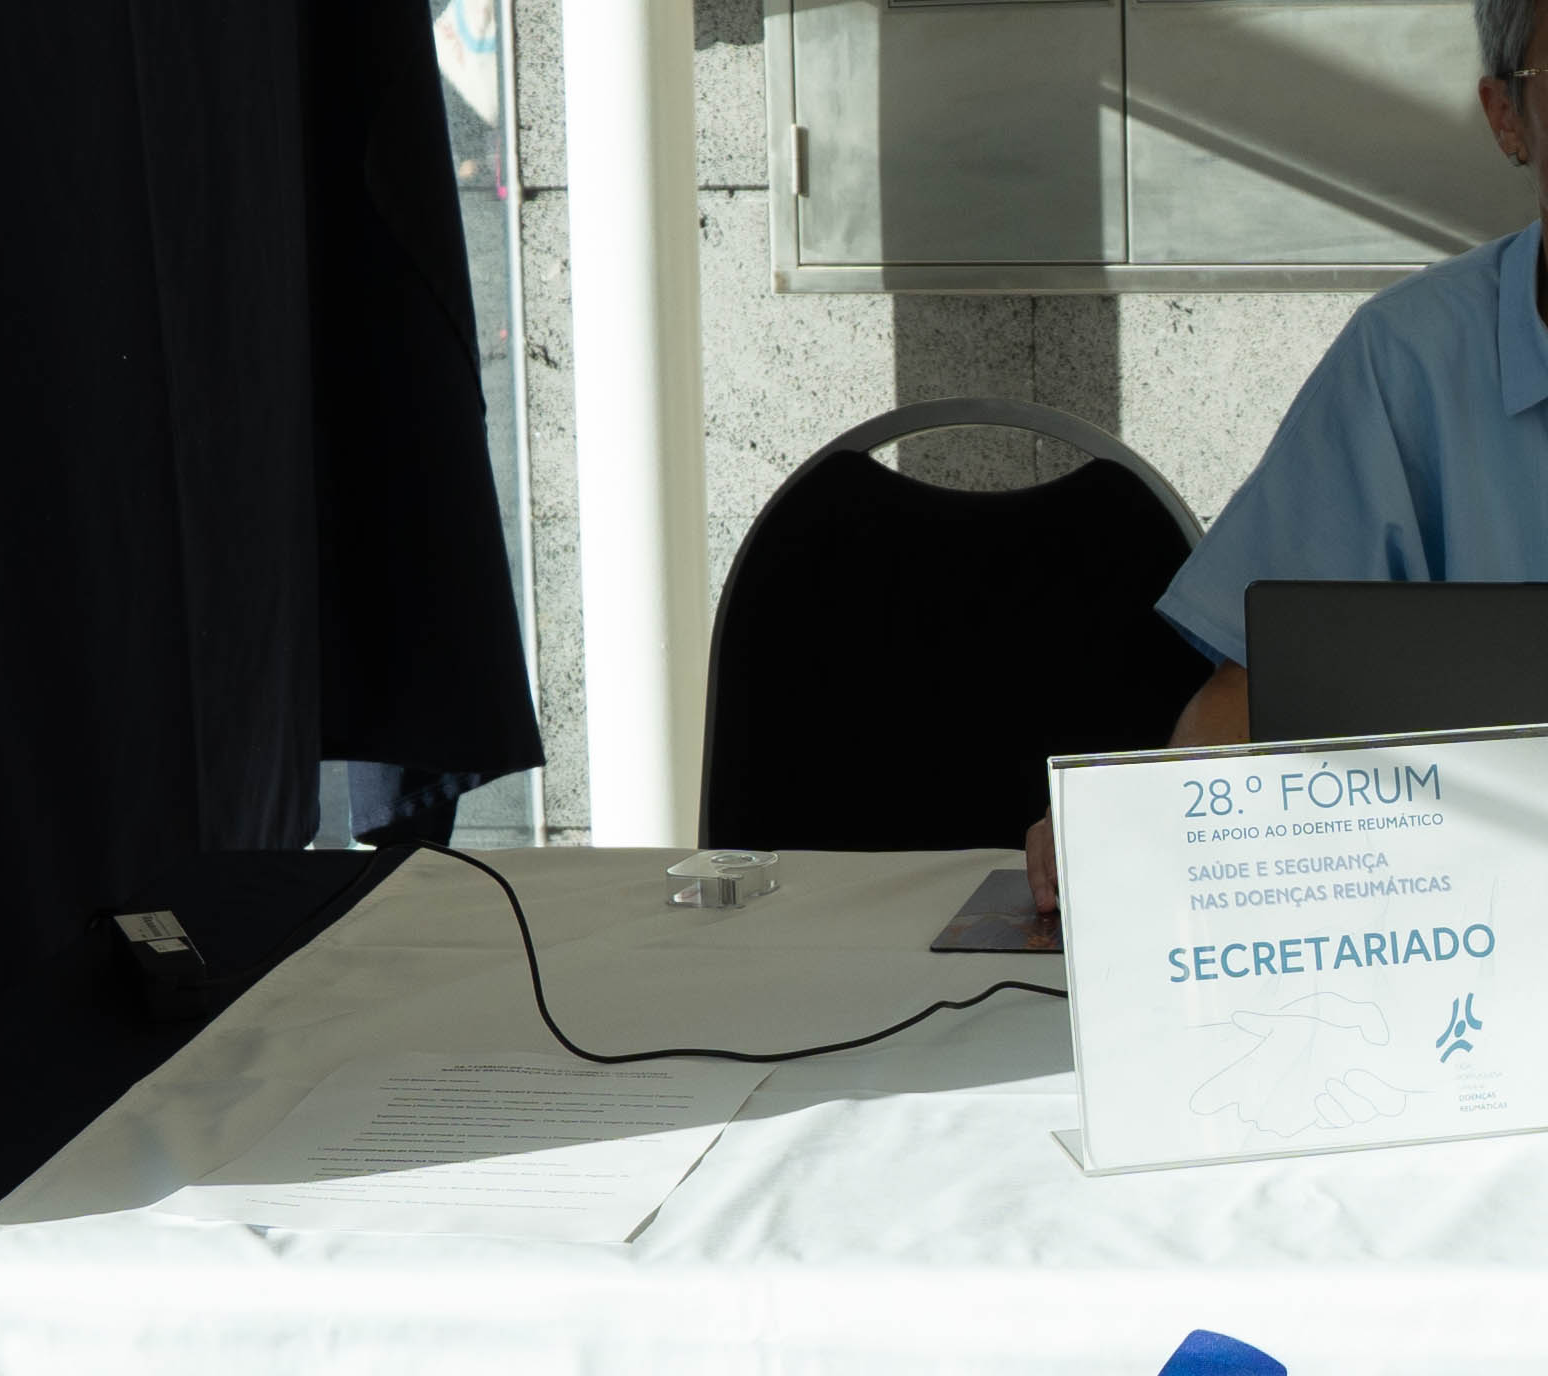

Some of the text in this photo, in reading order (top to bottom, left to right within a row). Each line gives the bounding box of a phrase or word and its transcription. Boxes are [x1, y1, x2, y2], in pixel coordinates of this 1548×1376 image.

[1183, 762, 1441, 818] 28.º FÓRUM
[1187, 813, 1444, 843] DE APOIO AO DOENTE REUMÁTICO
[1188, 852, 1389, 882] SAÚDE E SEGURANÇA
[1190, 875, 1451, 911] NAS DOENÇAS REUMÁTICAS
[1168, 923, 1496, 983] SECRETARIADO
